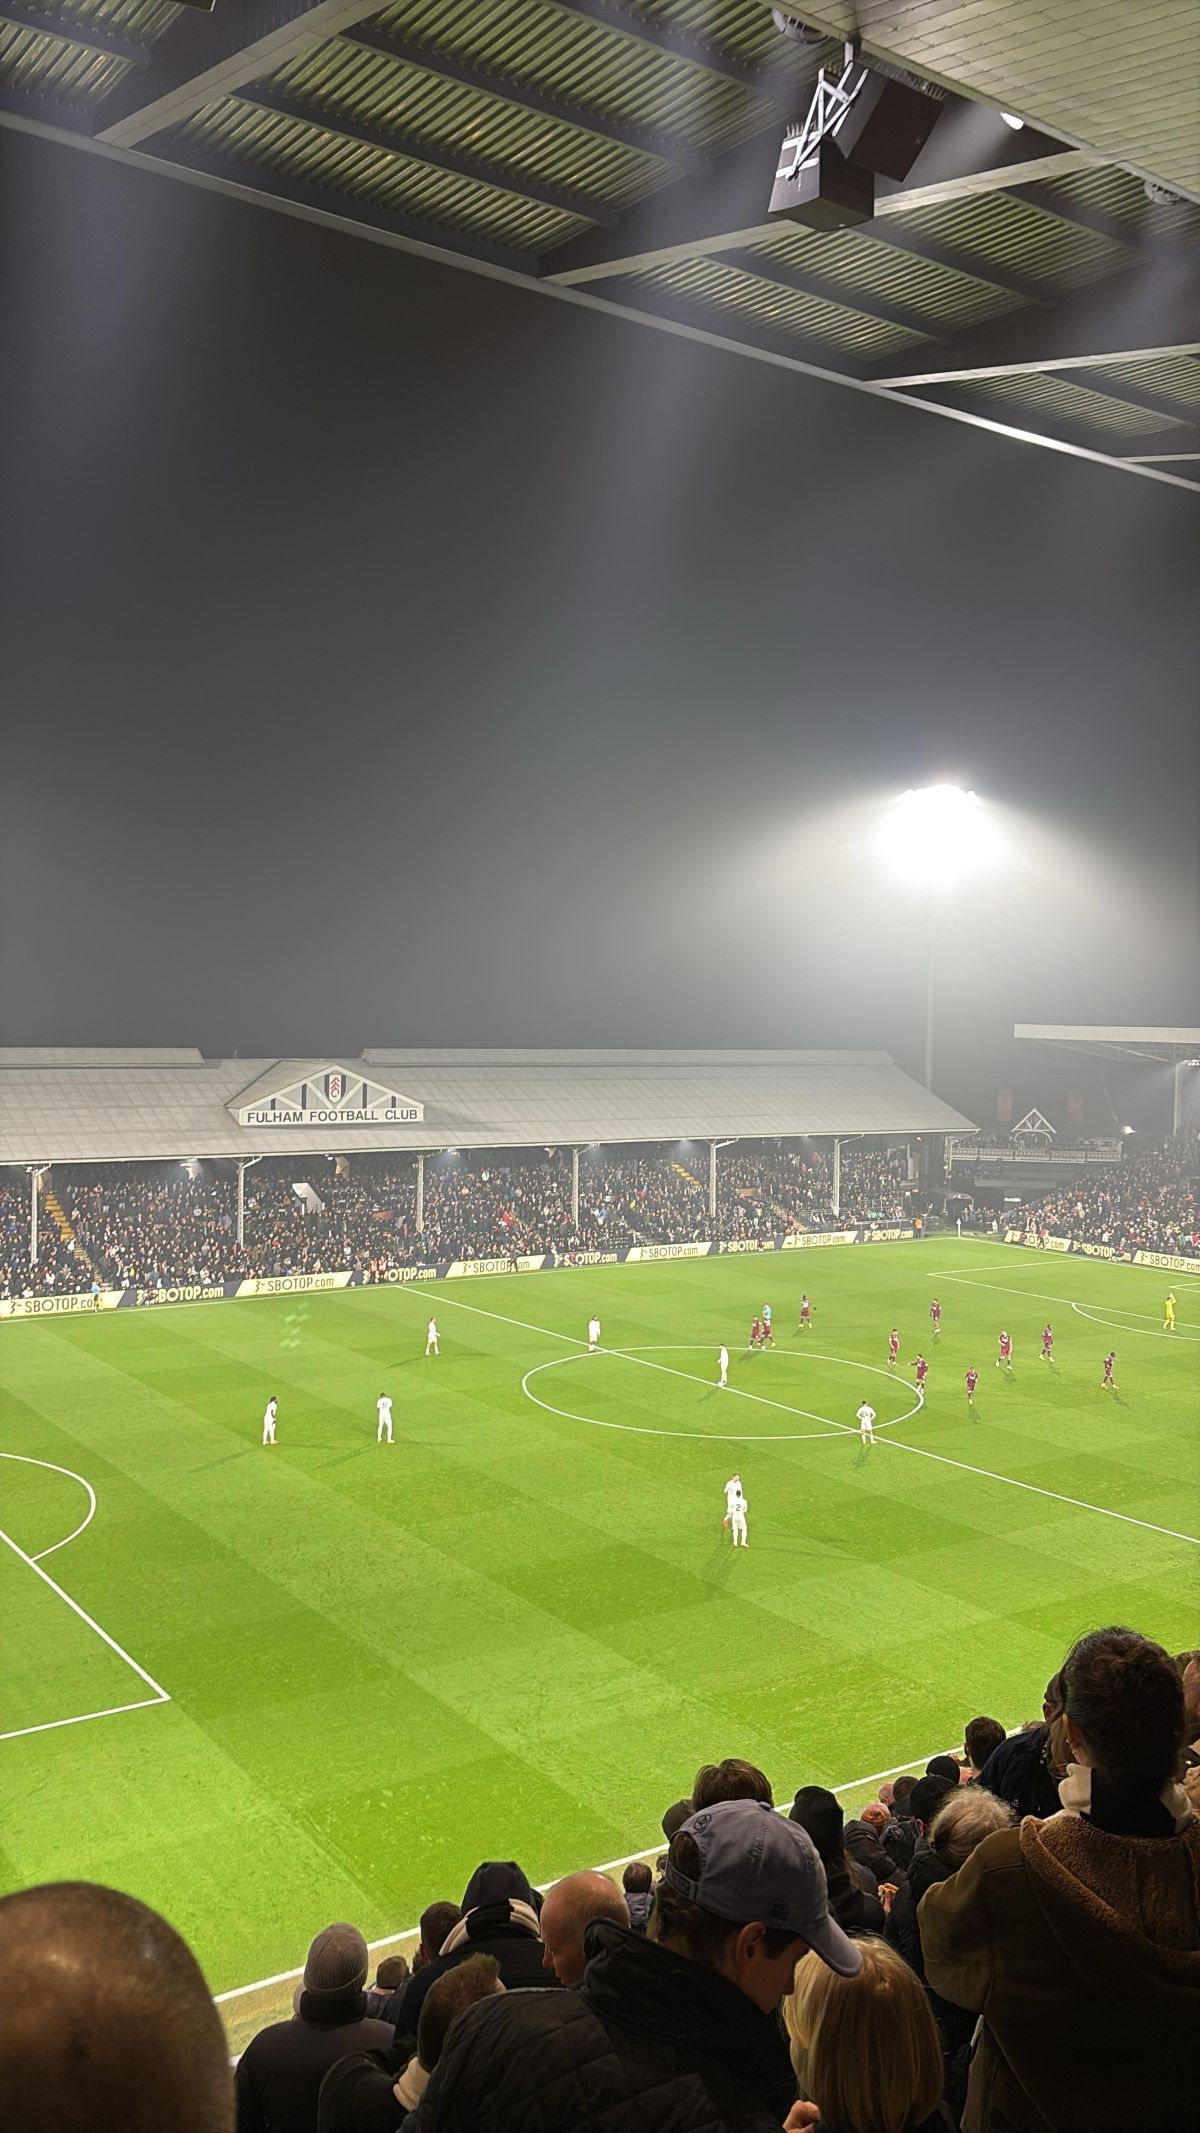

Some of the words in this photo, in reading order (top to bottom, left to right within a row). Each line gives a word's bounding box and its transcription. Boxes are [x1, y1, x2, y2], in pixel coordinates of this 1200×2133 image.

[247, 1111, 303, 1123] FULHAM
[309, 1110, 378, 1122] FOOTBALL
[385, 1109, 418, 1120] CLUB
[872, 1229, 914, 1241] SBOTOP.com
[649, 1246, 698, 1258] SBOTOP.com
[727, 1239, 775, 1253] SBOTOom
[1081, 1243, 1132, 1262] SBOTOPm
[564, 1251, 617, 1267] SOTOP.com
[473, 1260, 530, 1274] SBOTOPom
[375, 1267, 437, 1283] SOTOP.com
[267, 1277, 334, 1292] SBOTOP.com
